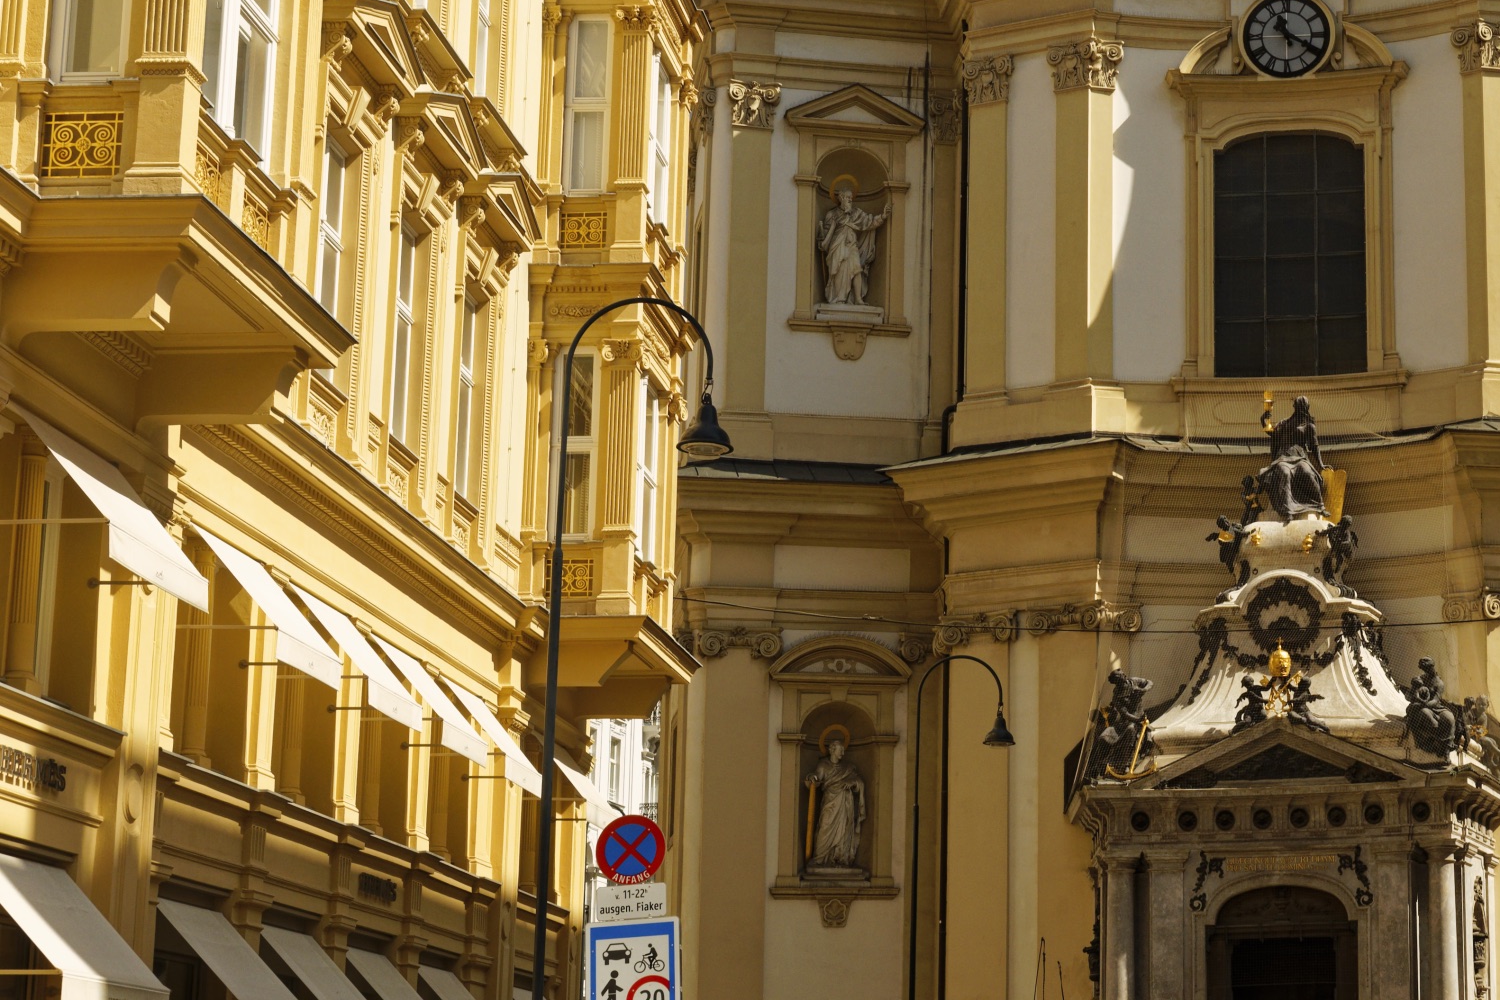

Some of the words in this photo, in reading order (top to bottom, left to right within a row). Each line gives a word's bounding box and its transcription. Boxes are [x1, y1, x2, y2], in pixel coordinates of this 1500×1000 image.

[1, 744, 67, 791] HERMÈS
[611, 870, 650, 884] ANFANG
[599, 905, 634, 916] ausgen.
[636, 902, 663, 912] Fiaker
